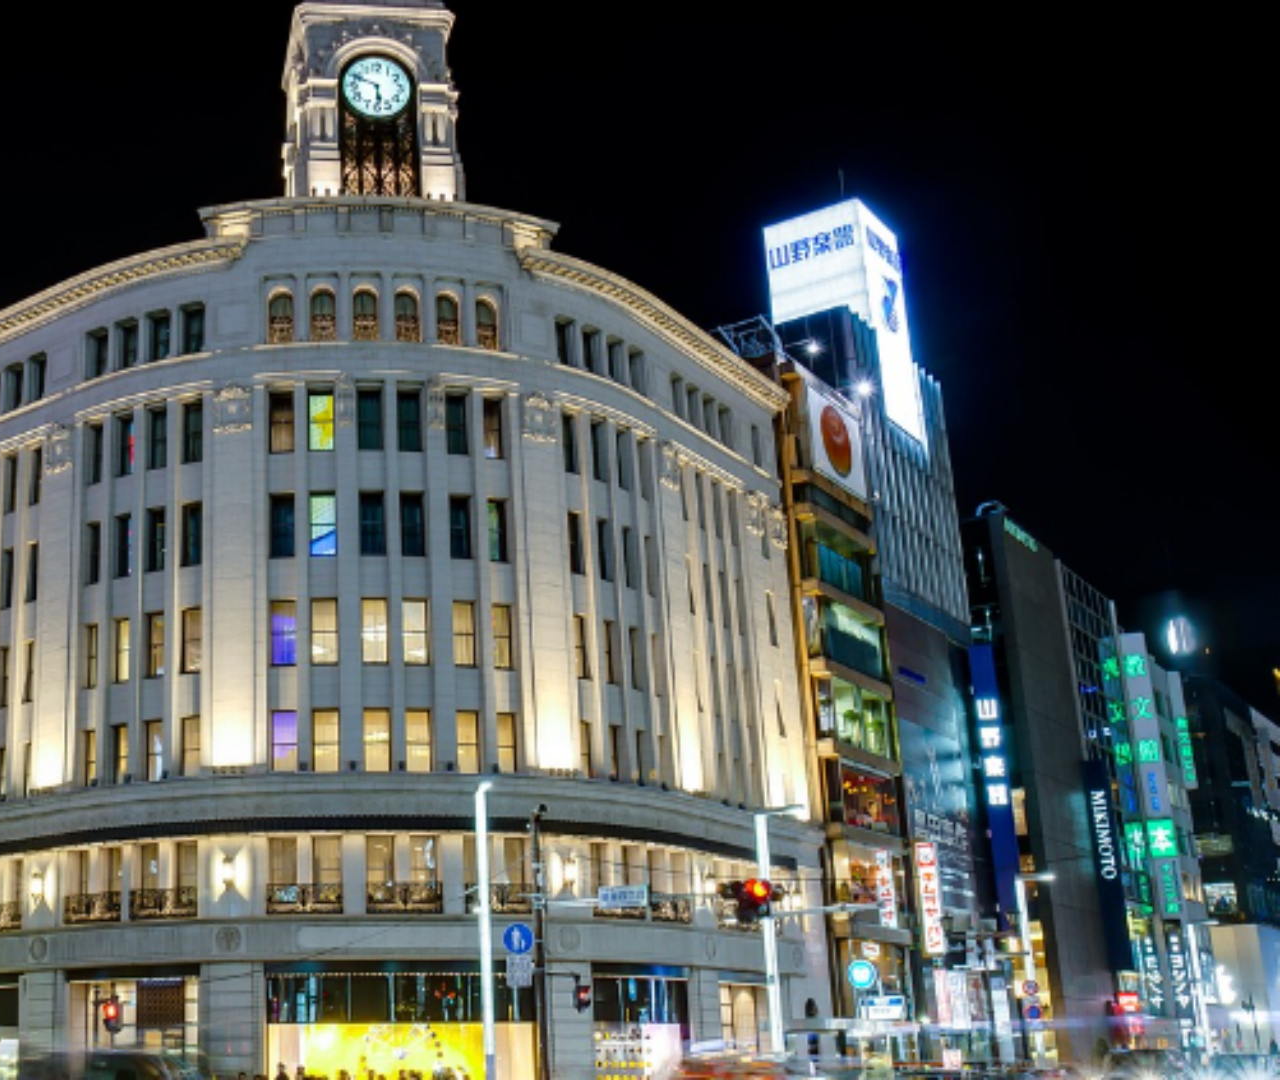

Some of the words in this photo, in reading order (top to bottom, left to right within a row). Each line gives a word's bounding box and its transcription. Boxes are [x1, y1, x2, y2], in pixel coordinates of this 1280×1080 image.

[768, 223, 855, 270] 山野楽器
[1091, 790, 1118, 880] MIKIMOTO
